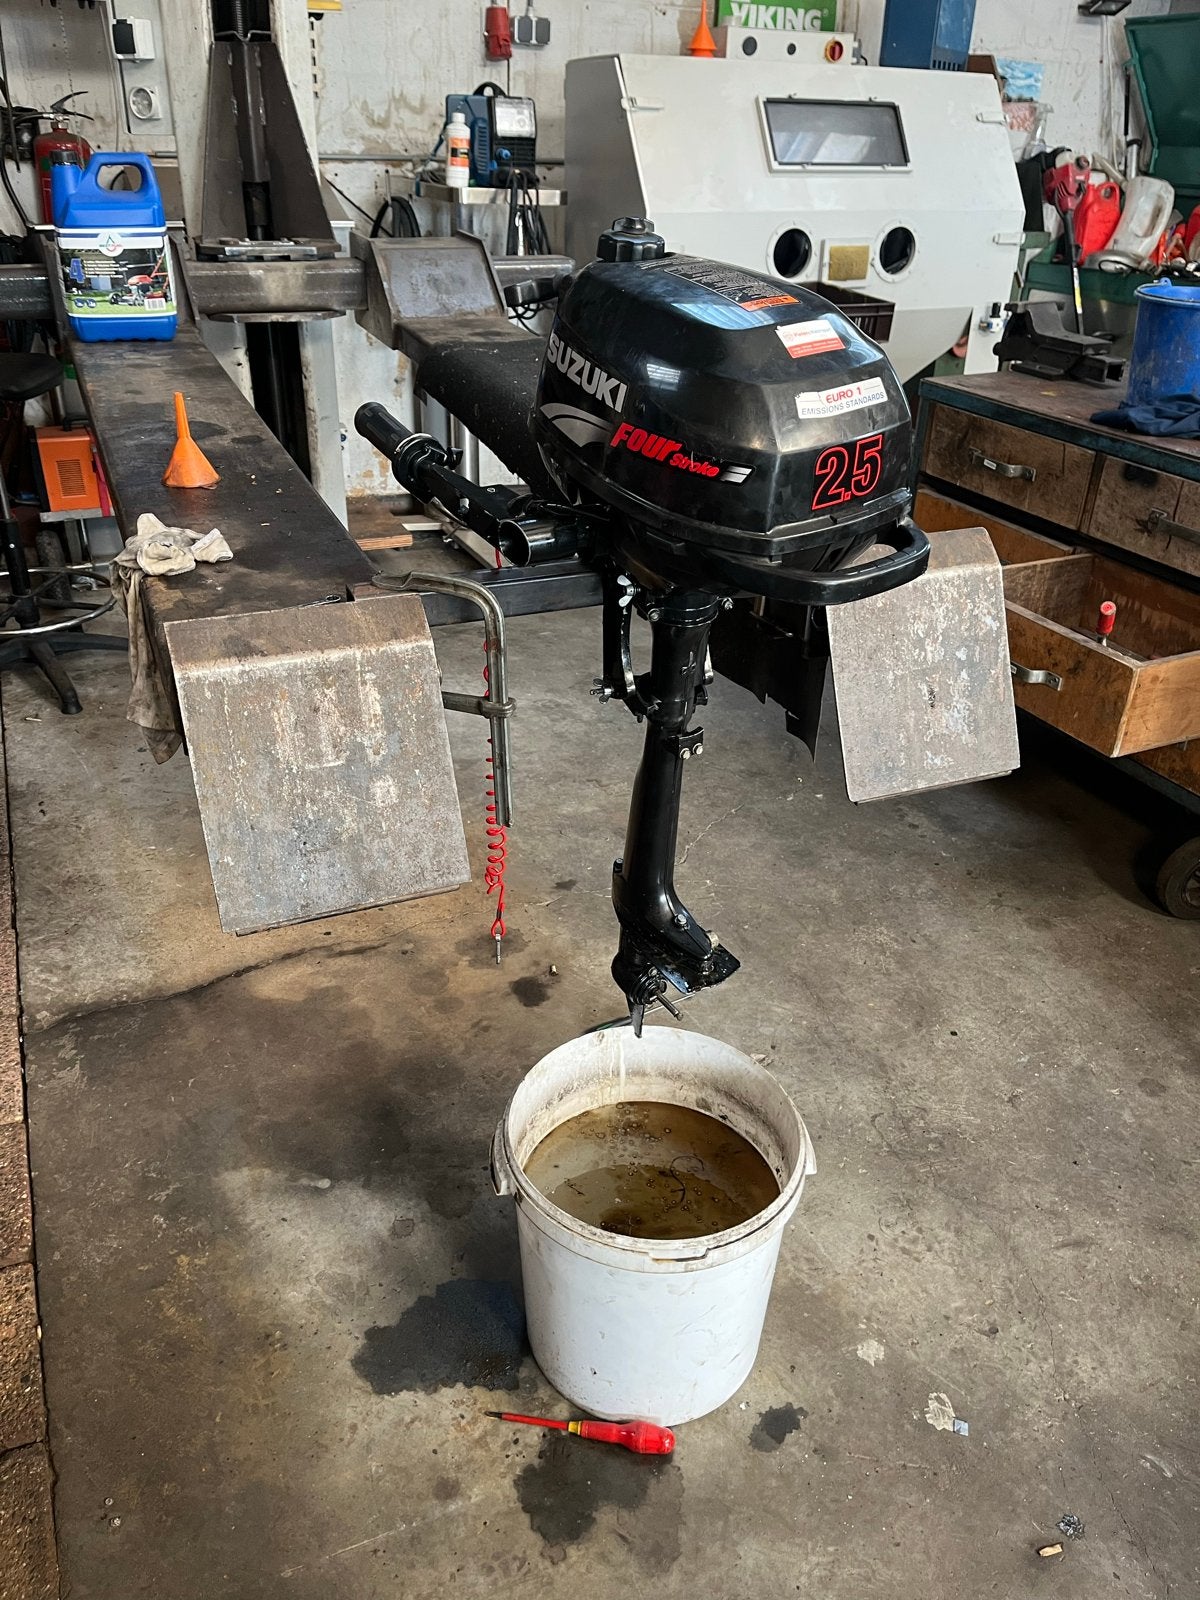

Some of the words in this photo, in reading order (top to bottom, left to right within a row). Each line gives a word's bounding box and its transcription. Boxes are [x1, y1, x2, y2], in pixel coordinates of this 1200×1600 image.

[731, 3, 822, 31] VIKING
[547, 331, 628, 413] SUZUKI
[801, 402, 844, 416] EMISSIONS
[845, 391, 885, 408] STANDARDS
[826, 389, 853, 404] EURO
[856, 387, 863, 396] 1
[812, 434, 883, 511] 2.5
